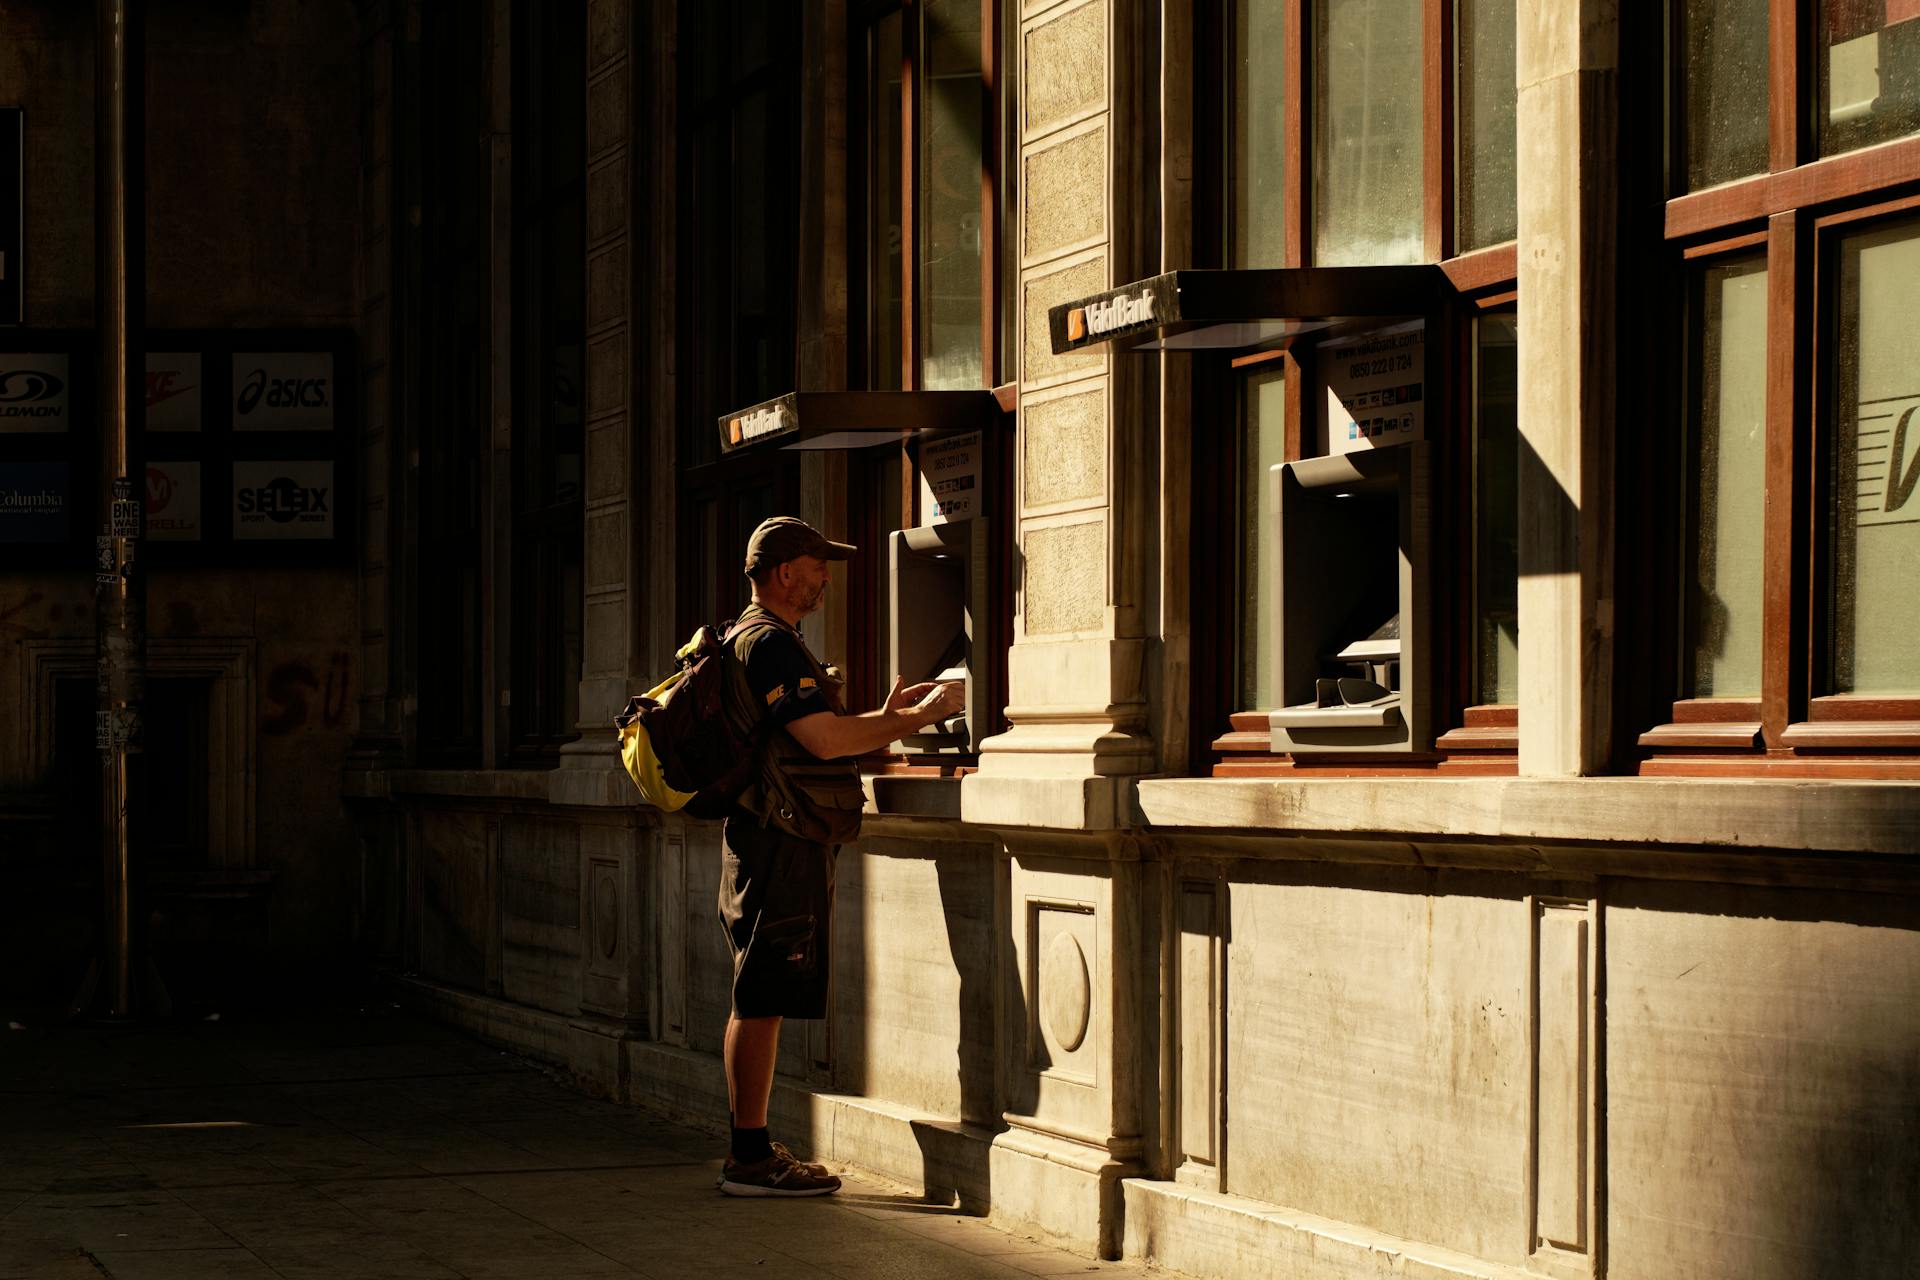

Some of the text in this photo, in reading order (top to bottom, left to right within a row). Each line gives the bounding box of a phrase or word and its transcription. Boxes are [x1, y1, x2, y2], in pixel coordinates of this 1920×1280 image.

[1372, 358, 1388, 375] 222
[1389, 357, 1395, 372] 0
[1396, 352, 1412, 372] 724
[113, 503, 138, 518] BNE
[114, 519, 138, 527] WAS
[114, 528, 138, 537] HERE
